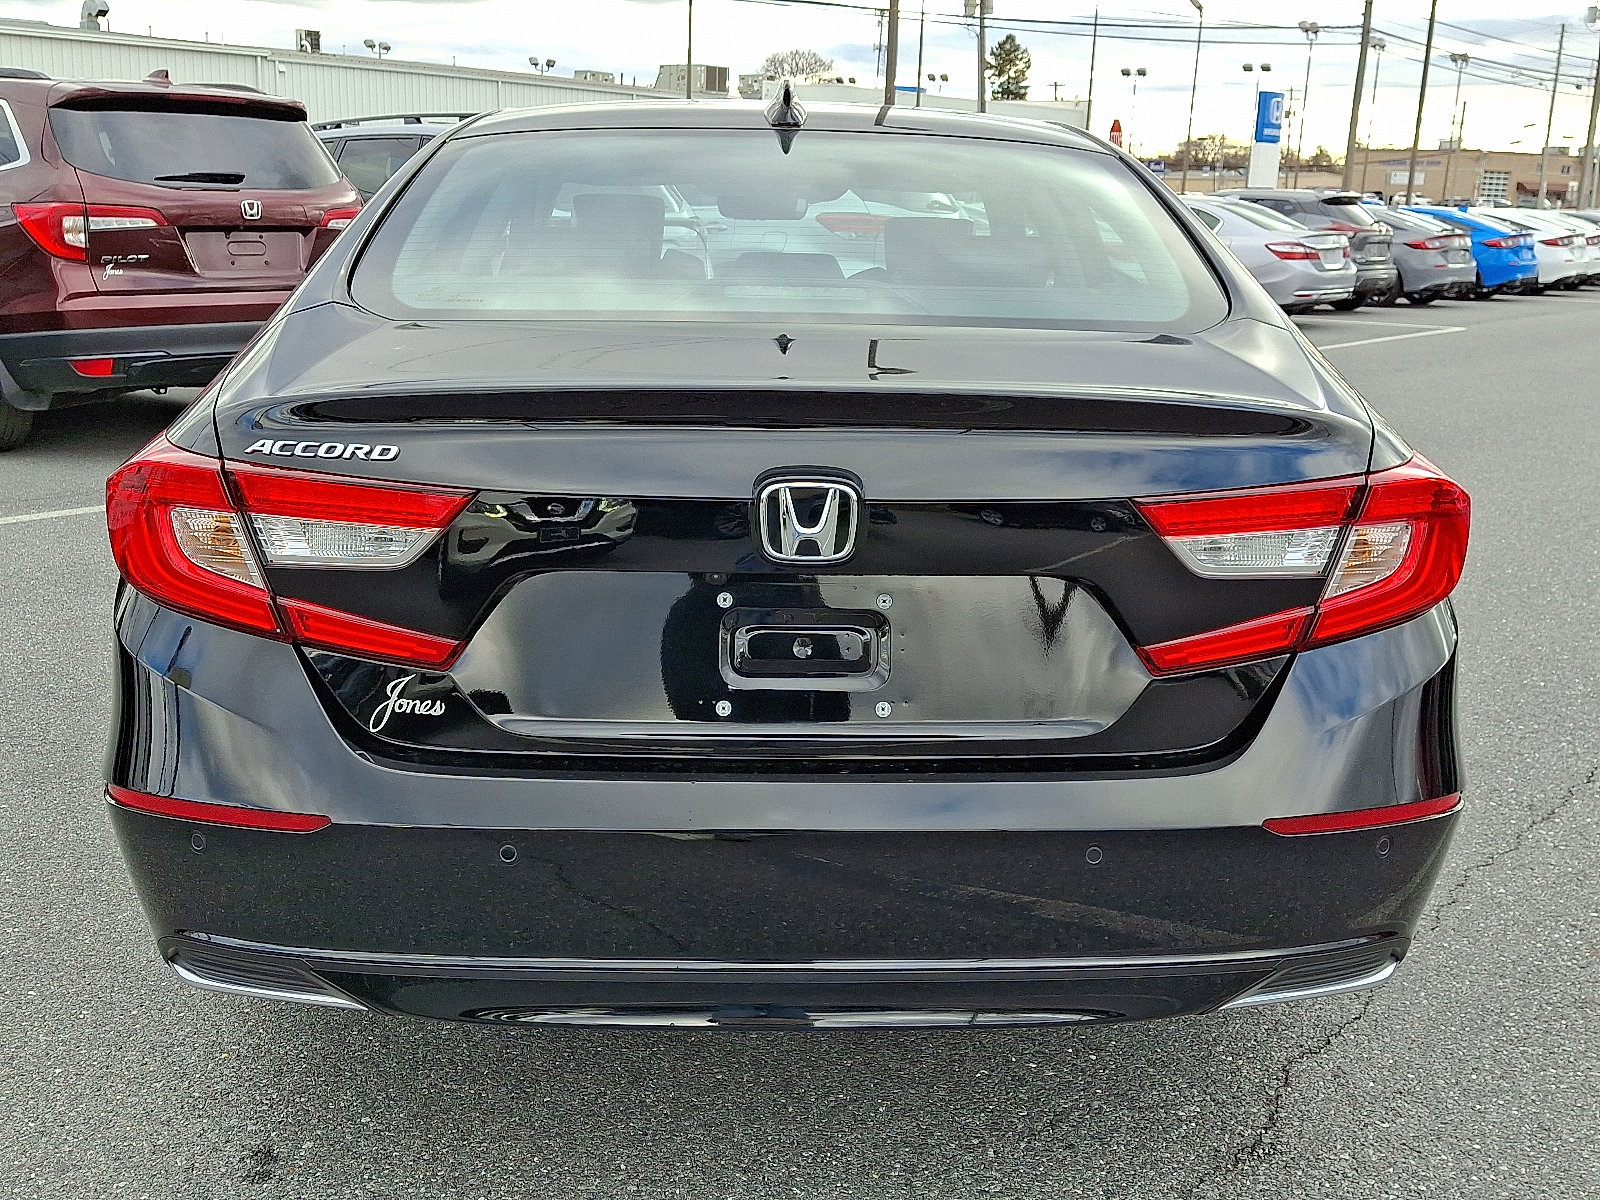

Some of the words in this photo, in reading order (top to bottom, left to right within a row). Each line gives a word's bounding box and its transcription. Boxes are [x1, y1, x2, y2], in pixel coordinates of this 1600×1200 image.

[100, 254, 150, 263] PILOT
[102, 263, 124, 281] Jones
[245, 439, 400, 462] ACCORD
[369, 674, 446, 734] Jones
